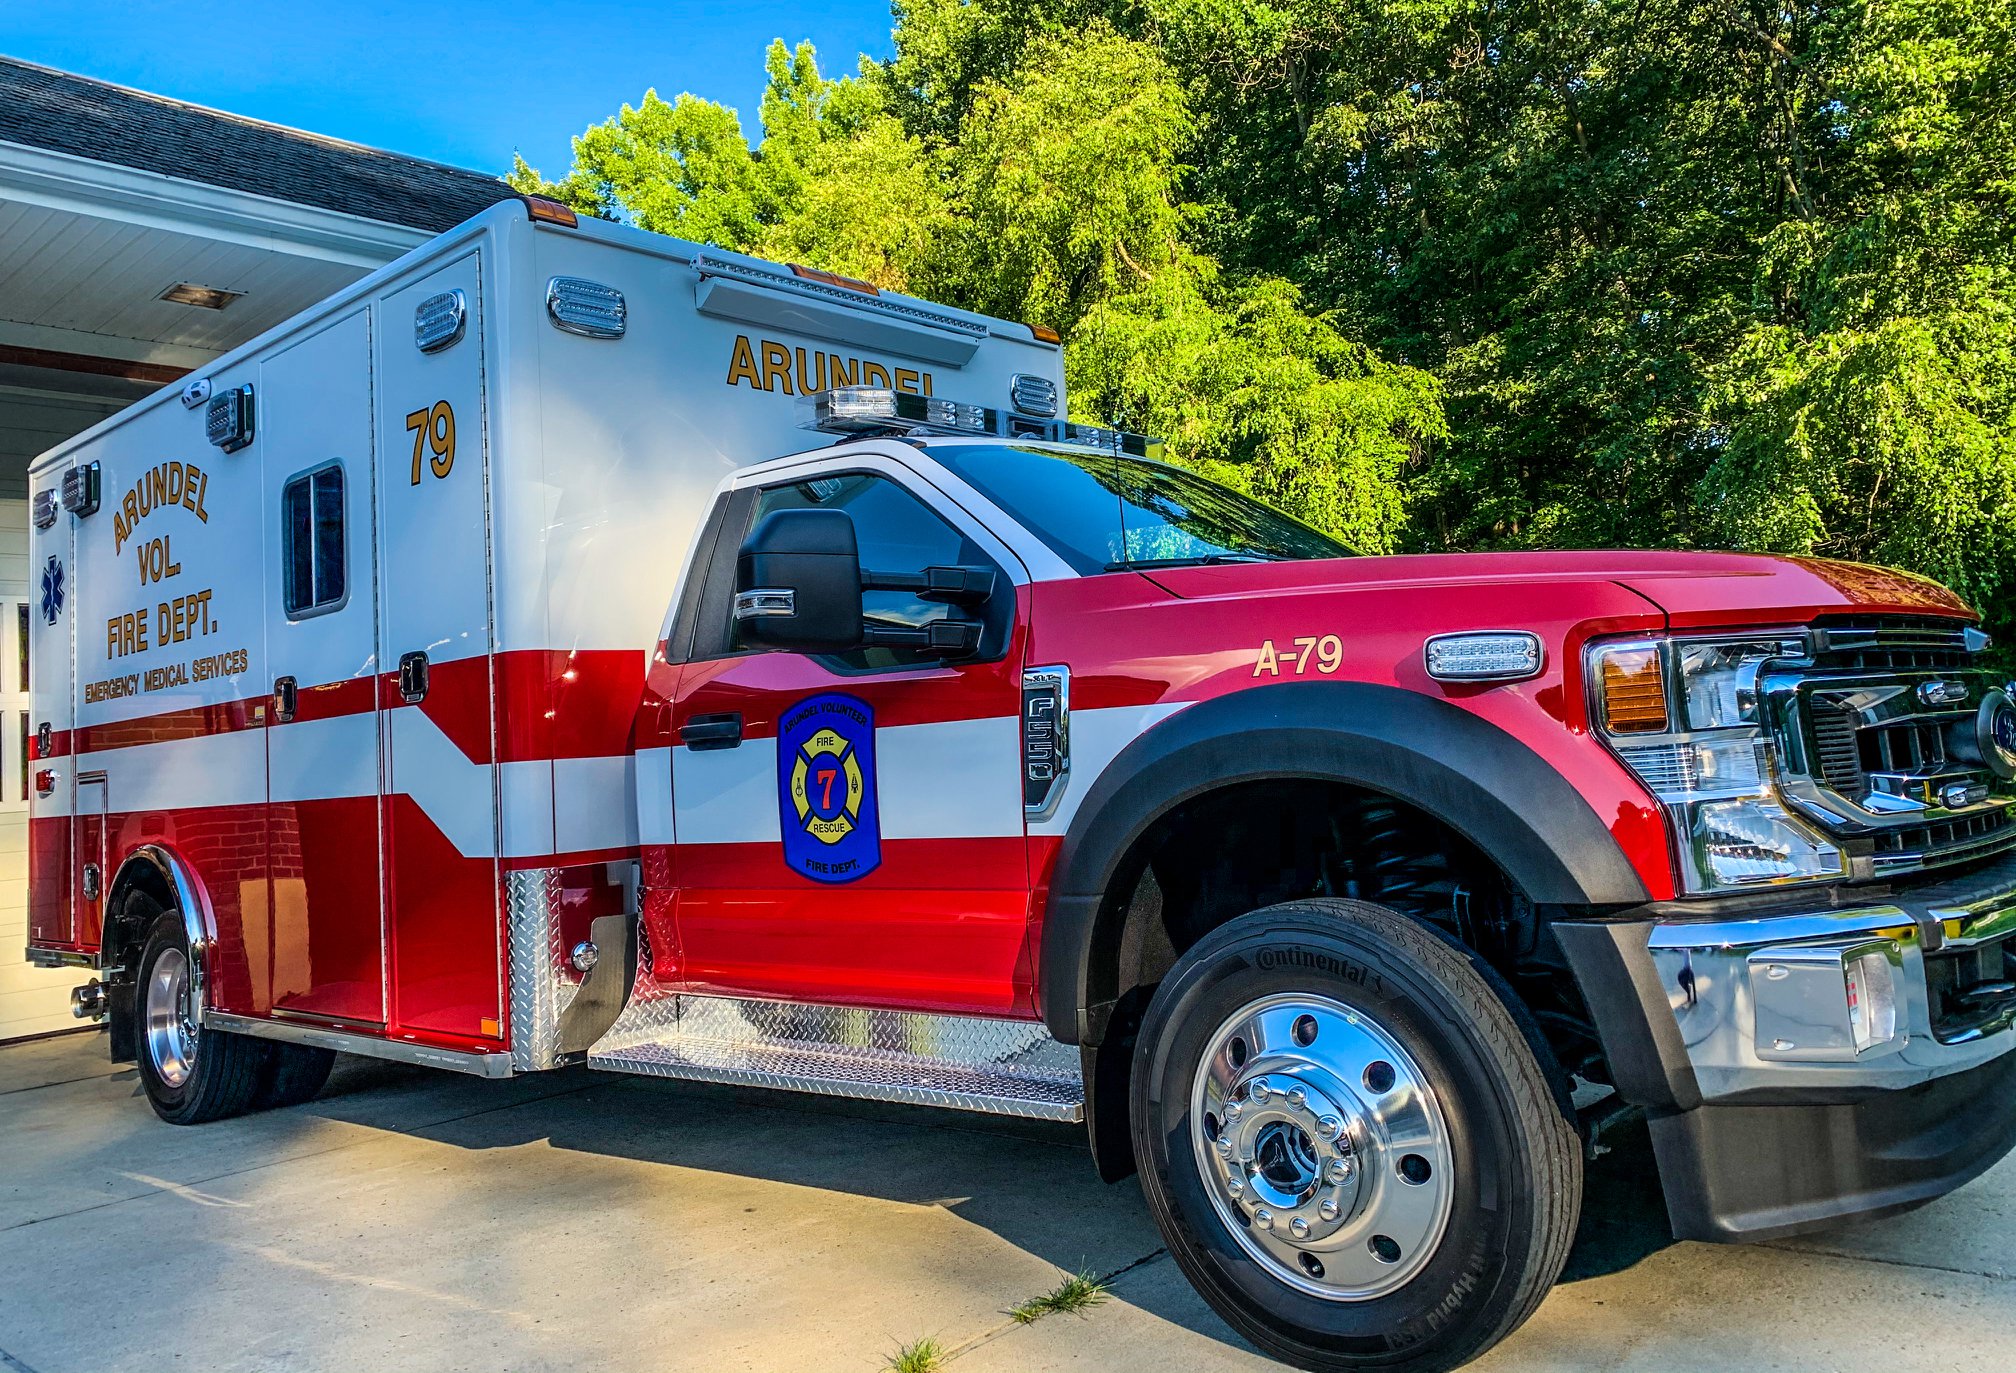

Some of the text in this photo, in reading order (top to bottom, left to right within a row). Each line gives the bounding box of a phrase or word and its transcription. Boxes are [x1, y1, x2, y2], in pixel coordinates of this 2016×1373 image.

[406, 400, 456, 486] 79
[113, 461, 208, 556] ARUNDEL
[137, 535, 181, 586] VOL.
[107, 588, 218, 660] FIRE DEPT.
[85, 648, 248, 704] EMERGENCY MEDICAL SERVICES
[1251, 634, 1344, 678] A-79
[784, 703, 868, 735] ARUNDEL VOLUNTEER
[816, 736, 834, 747] FIRE
[1028, 697, 1055, 781] F550
[817, 769, 837, 810] 7
[813, 823, 845, 833] RESCUE
[805, 858, 860, 874] FIRE DEPT.
[1255, 946, 1368, 987] Continental
[1426, 1272, 1477, 1331] Hybrid
